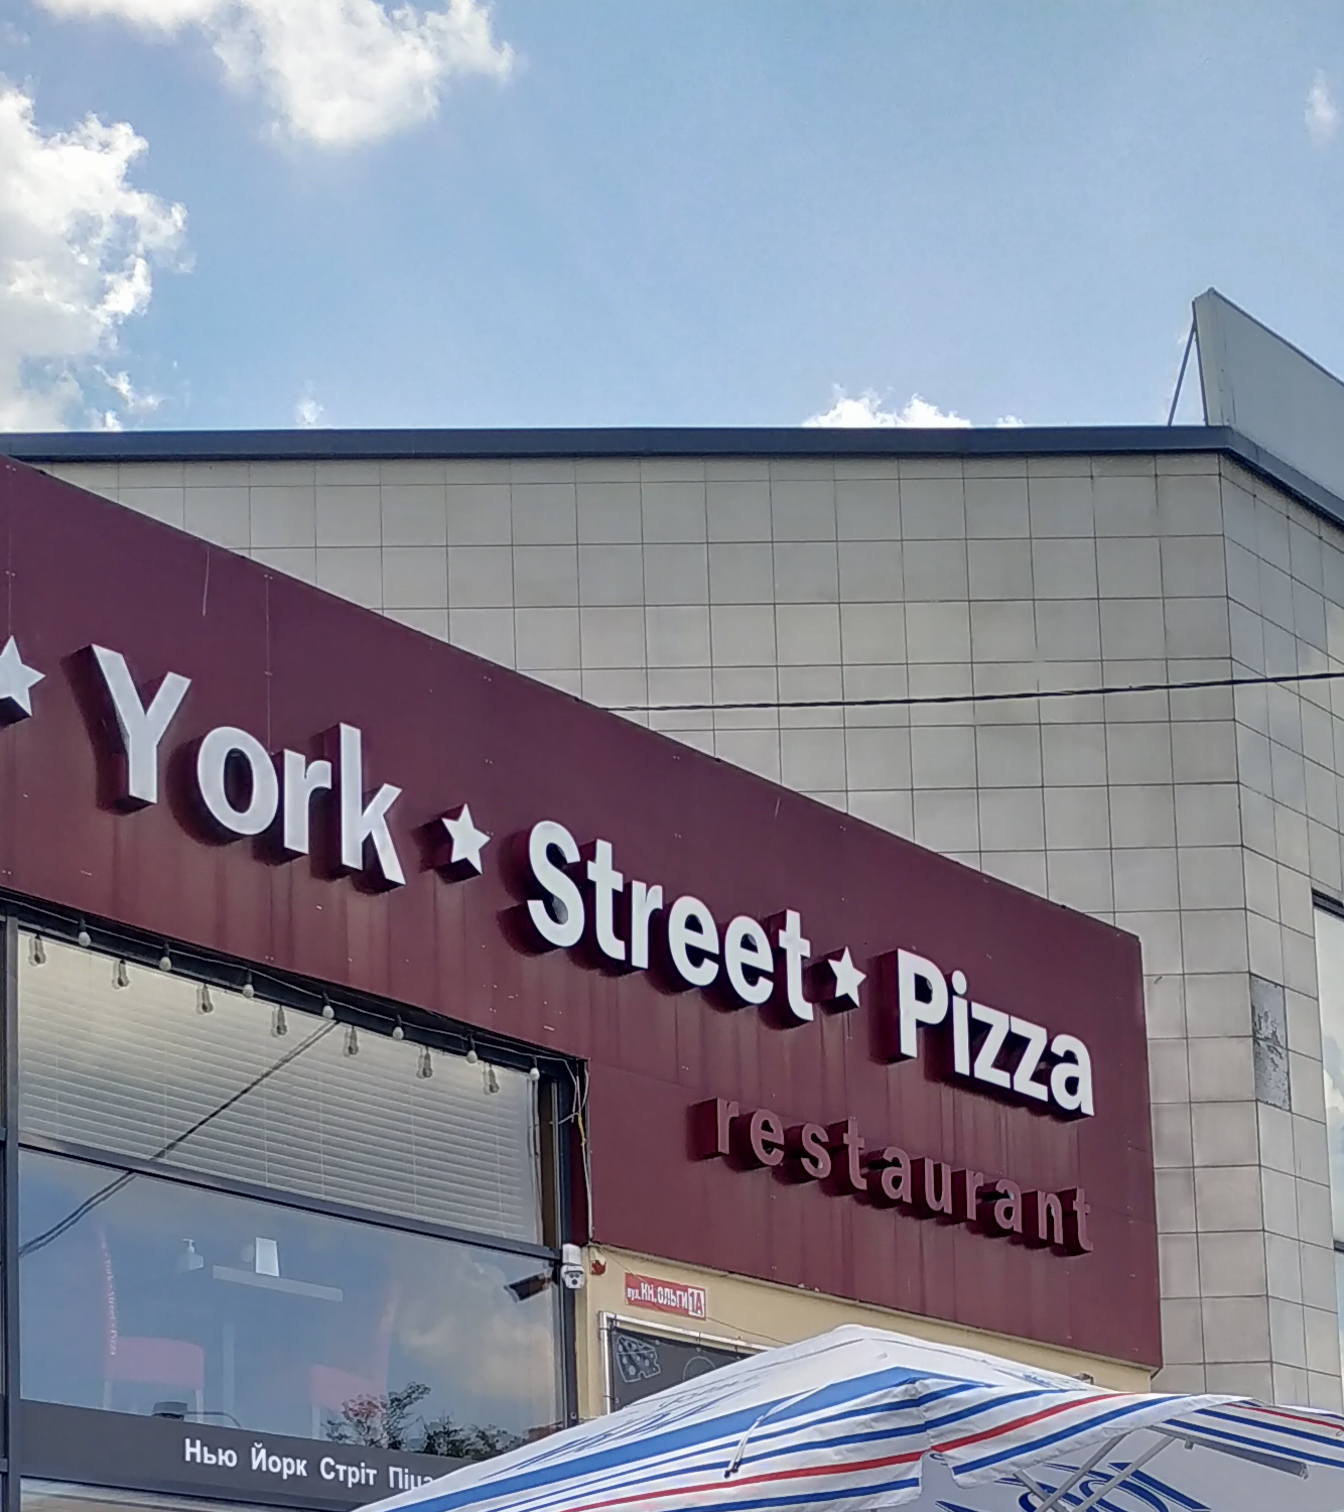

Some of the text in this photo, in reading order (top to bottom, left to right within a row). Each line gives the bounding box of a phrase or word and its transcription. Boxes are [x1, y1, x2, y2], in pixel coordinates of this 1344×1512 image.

[89, 642, 407, 886] York
[525, 818, 815, 1022] Street
[895, 947, 1096, 1118] Pizza
[716, 1097, 1095, 1252] restaurant
[184, 1437, 238, 1468] Нью
[251, 1442, 308, 1480] Йорк
[319, 1456, 378, 1489] Стріт
